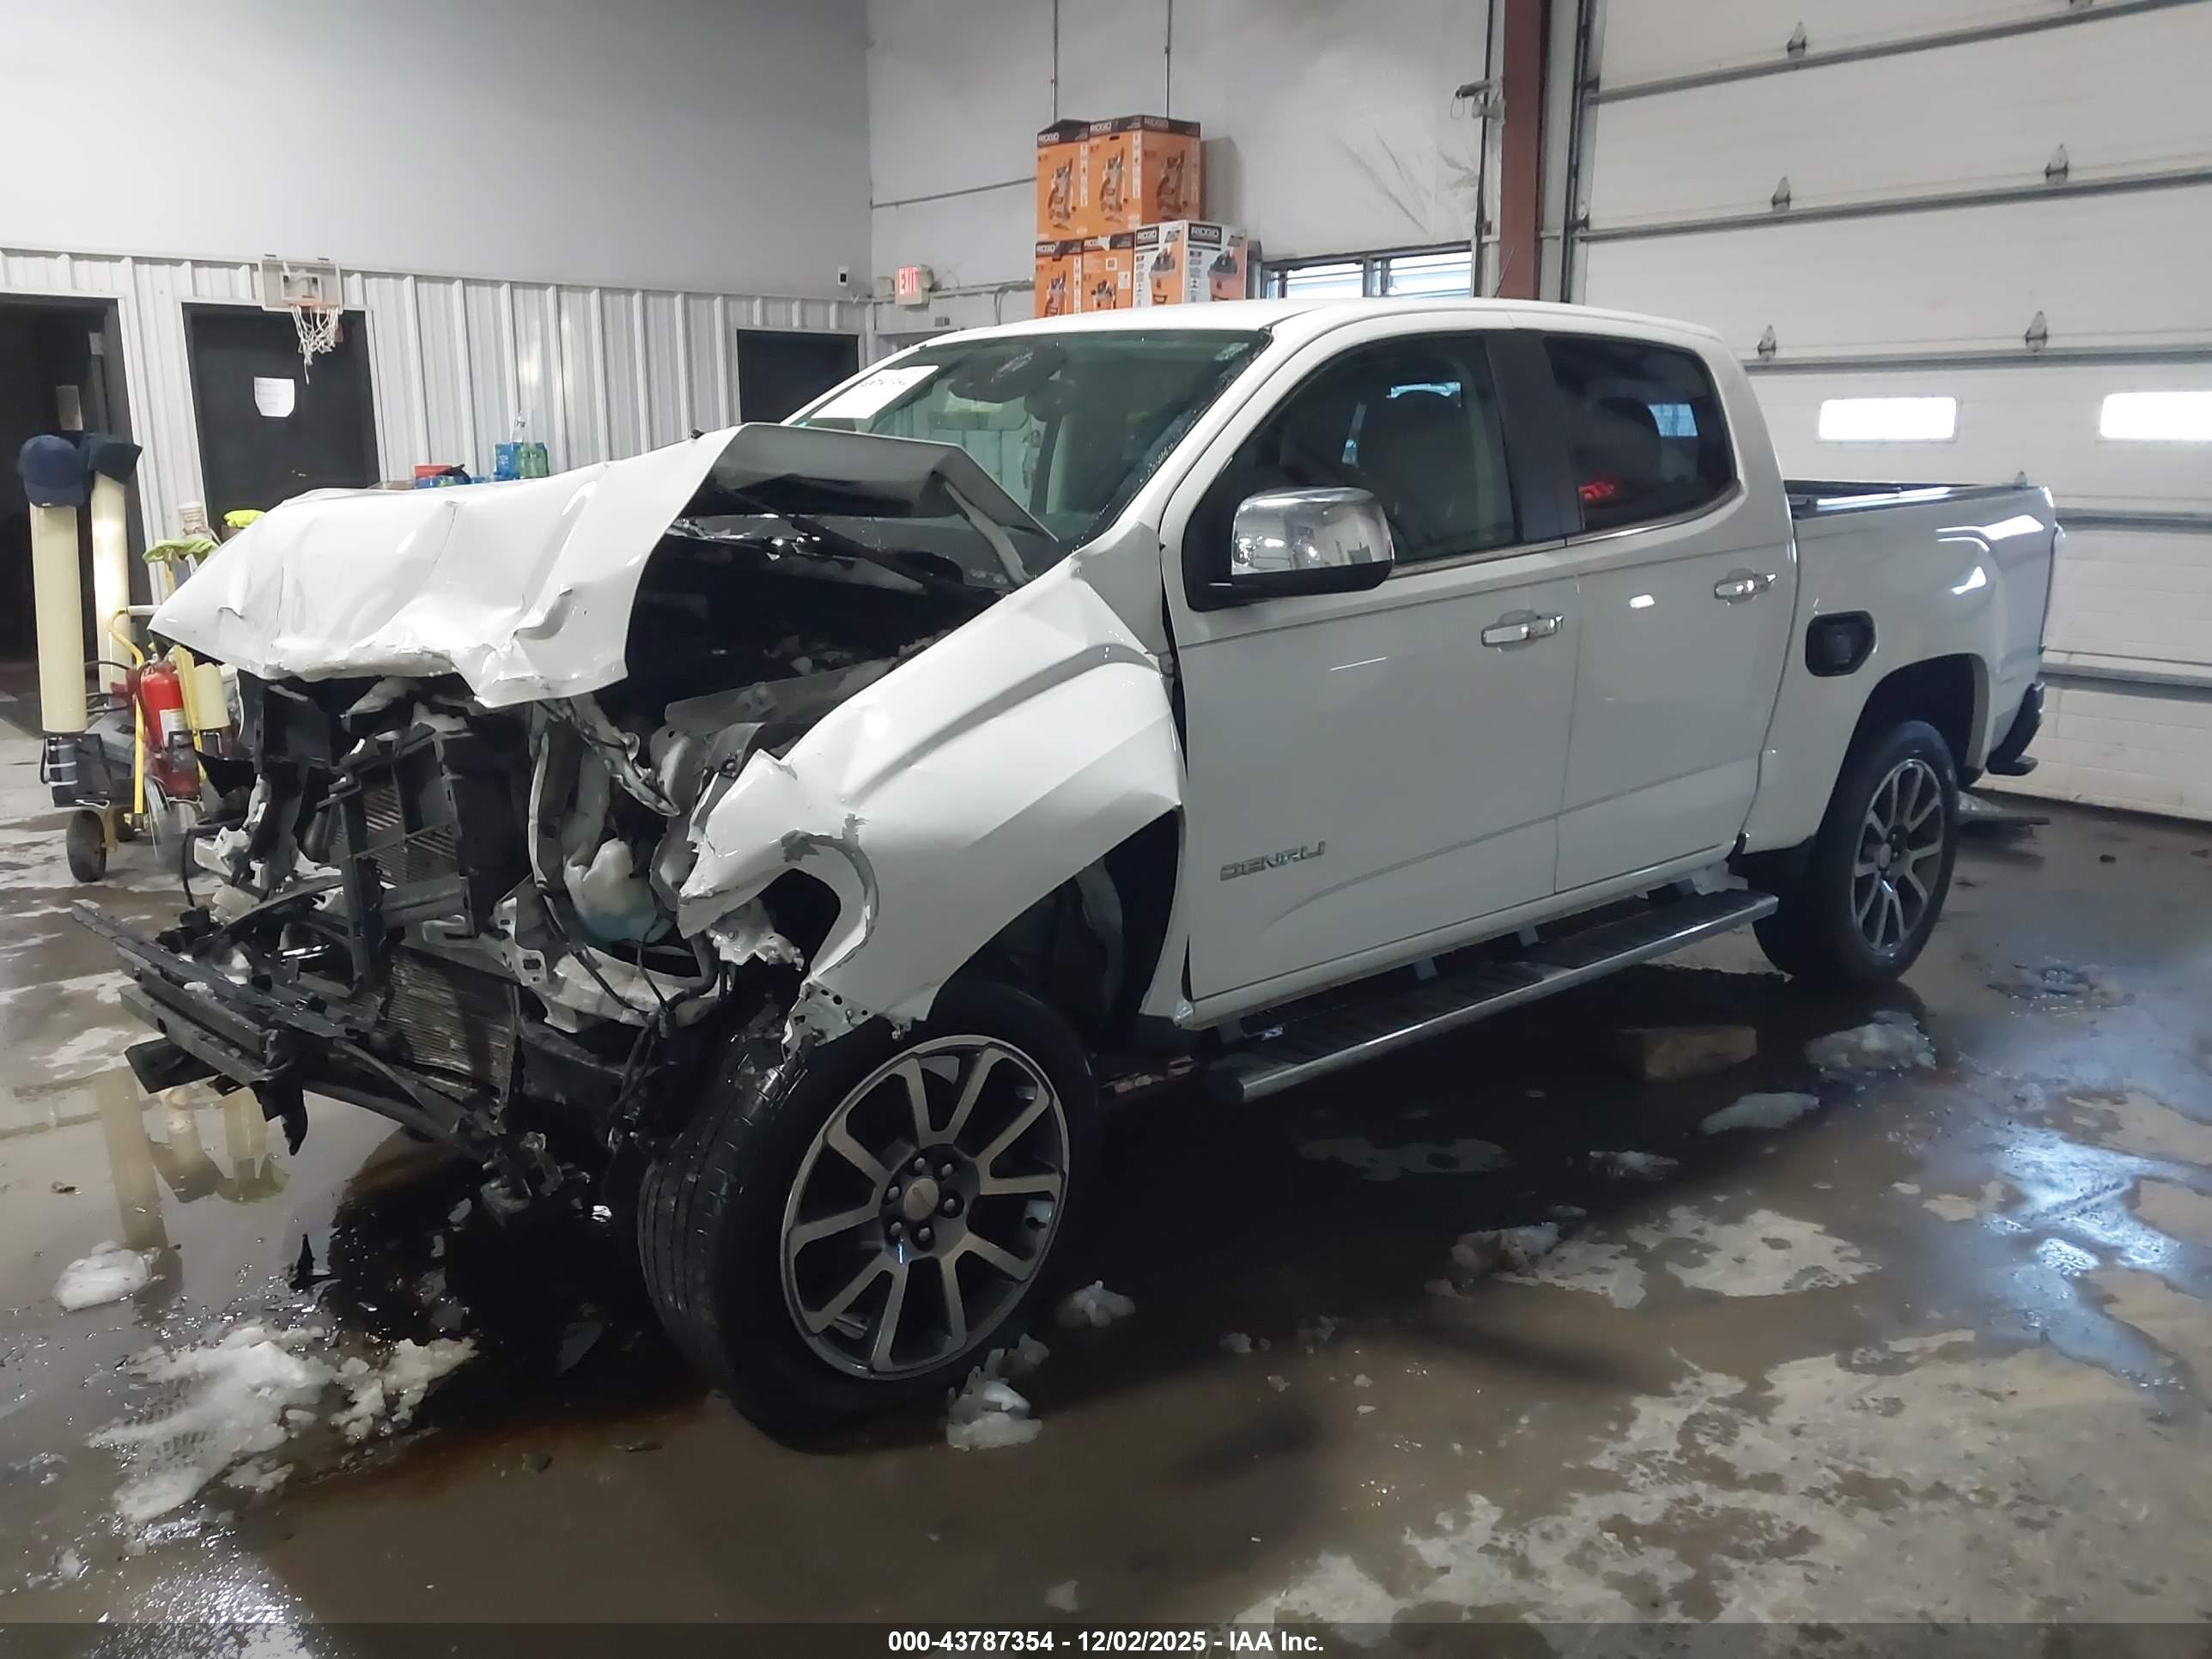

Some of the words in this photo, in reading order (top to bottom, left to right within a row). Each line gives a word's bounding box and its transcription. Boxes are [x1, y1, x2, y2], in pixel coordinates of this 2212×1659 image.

[1137, 229, 1158, 240] RIDGID
[1191, 226, 1219, 238] RIDGID
[899, 267, 919, 295] EXIT
[1219, 840, 1326, 881] DENALI
